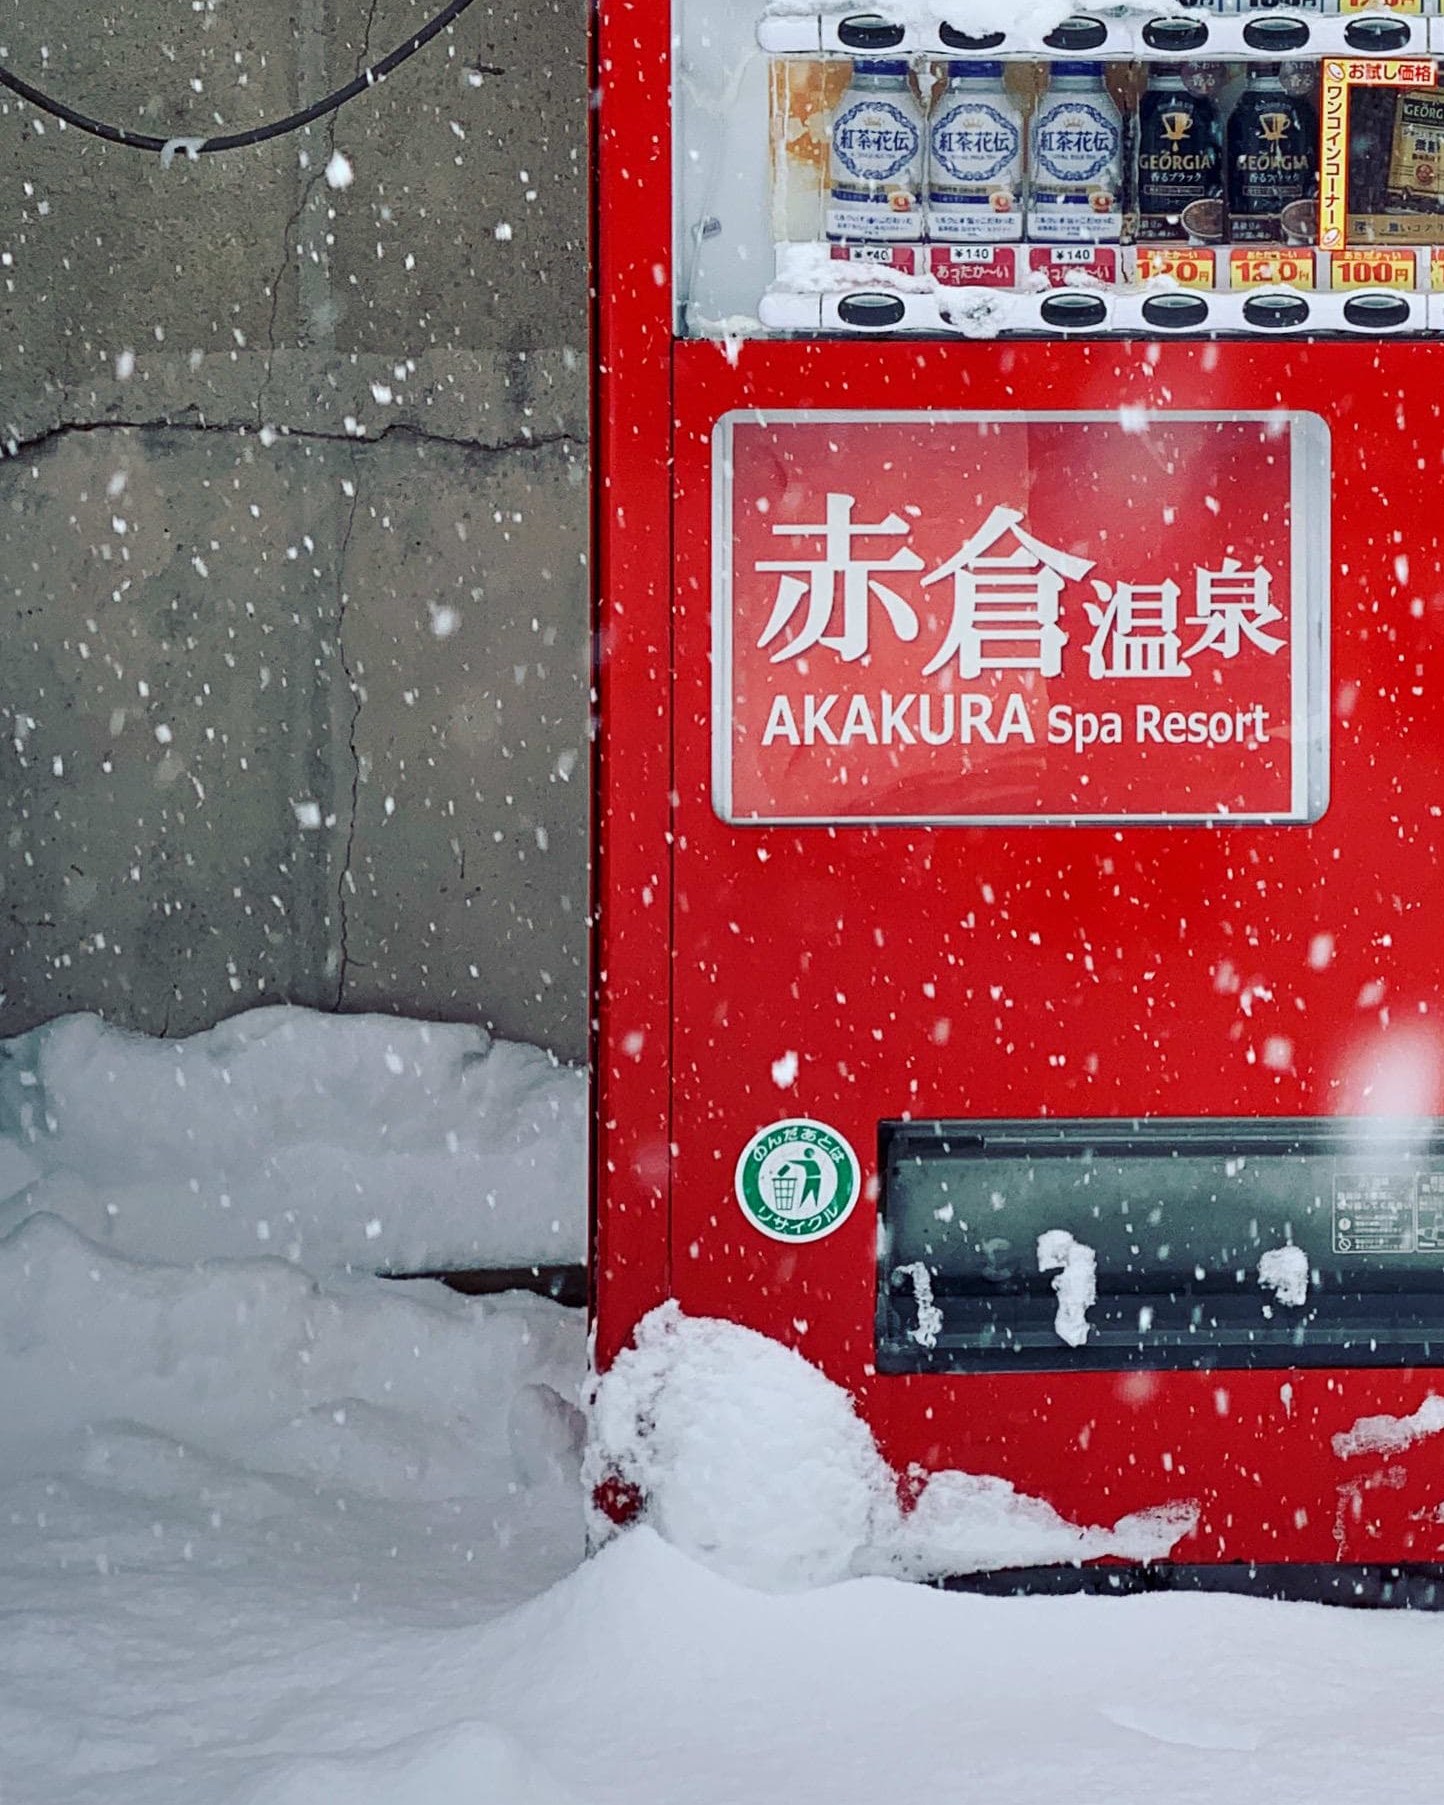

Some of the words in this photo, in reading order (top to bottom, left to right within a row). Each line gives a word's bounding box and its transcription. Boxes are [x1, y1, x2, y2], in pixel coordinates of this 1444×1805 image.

[1349, 63, 1432, 82] お試し価格
[840, 128, 910, 153] 紅茶花伝
[938, 129, 1011, 154] 紅茶花伝
[1040, 129, 1111, 154] 紅茶花伝
[1138, 150, 1212, 171] GEORGIA
[1326, 85, 1343, 225] ワンコインコーナー
[953, 247, 990, 260] ¥140
[1055, 249, 1091, 262] ¥140
[1337, 261, 1409, 284] 100円
[754, 491, 1289, 681] 赤倉温泉
[761, 692, 1035, 746] AKAKURA
[1047, 703, 1123, 754] Spa
[1135, 702, 1270, 745] Resort
[752, 1127, 846, 1164] のんだあとは
[756, 1205, 839, 1235] リサイクル
